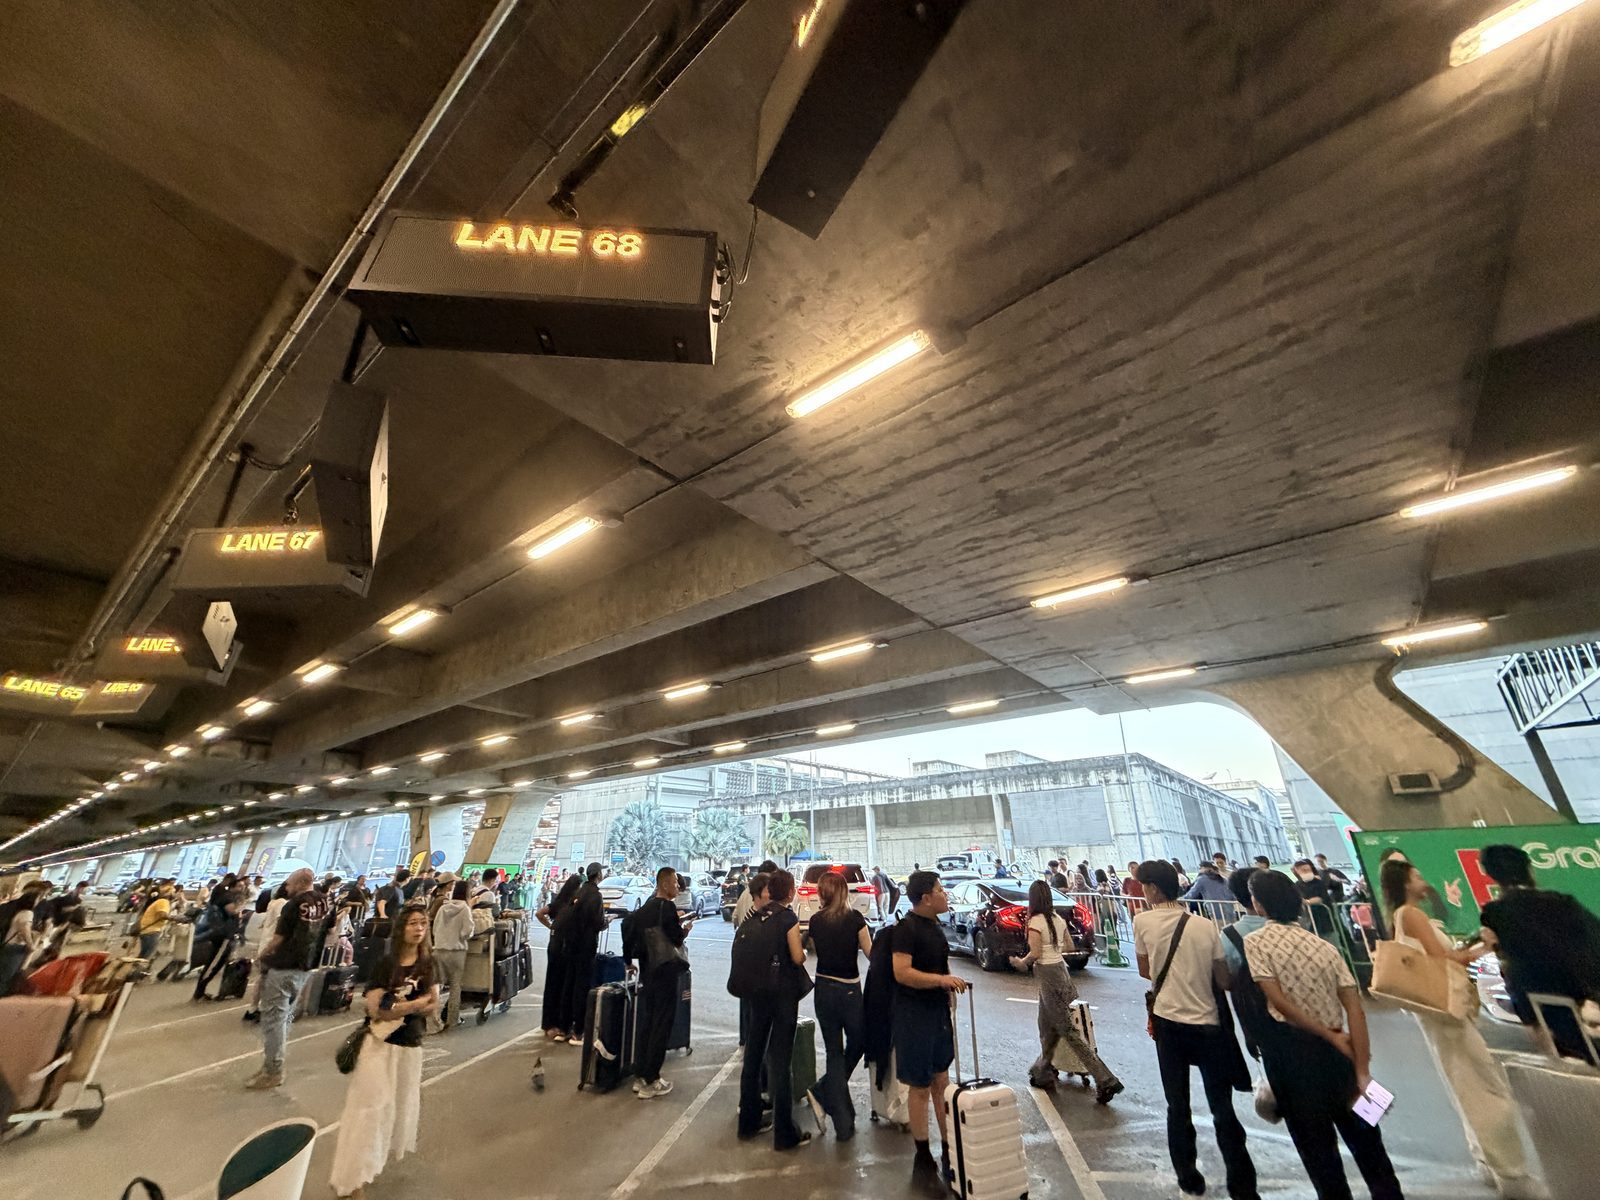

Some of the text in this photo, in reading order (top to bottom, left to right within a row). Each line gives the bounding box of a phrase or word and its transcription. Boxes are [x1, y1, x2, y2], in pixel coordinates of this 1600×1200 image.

[455, 222, 643, 257] LANE 68
[221, 530, 320, 552] LANE 67
[126, 637, 175, 652] LANE
[4, 677, 87, 700] LANE 65
